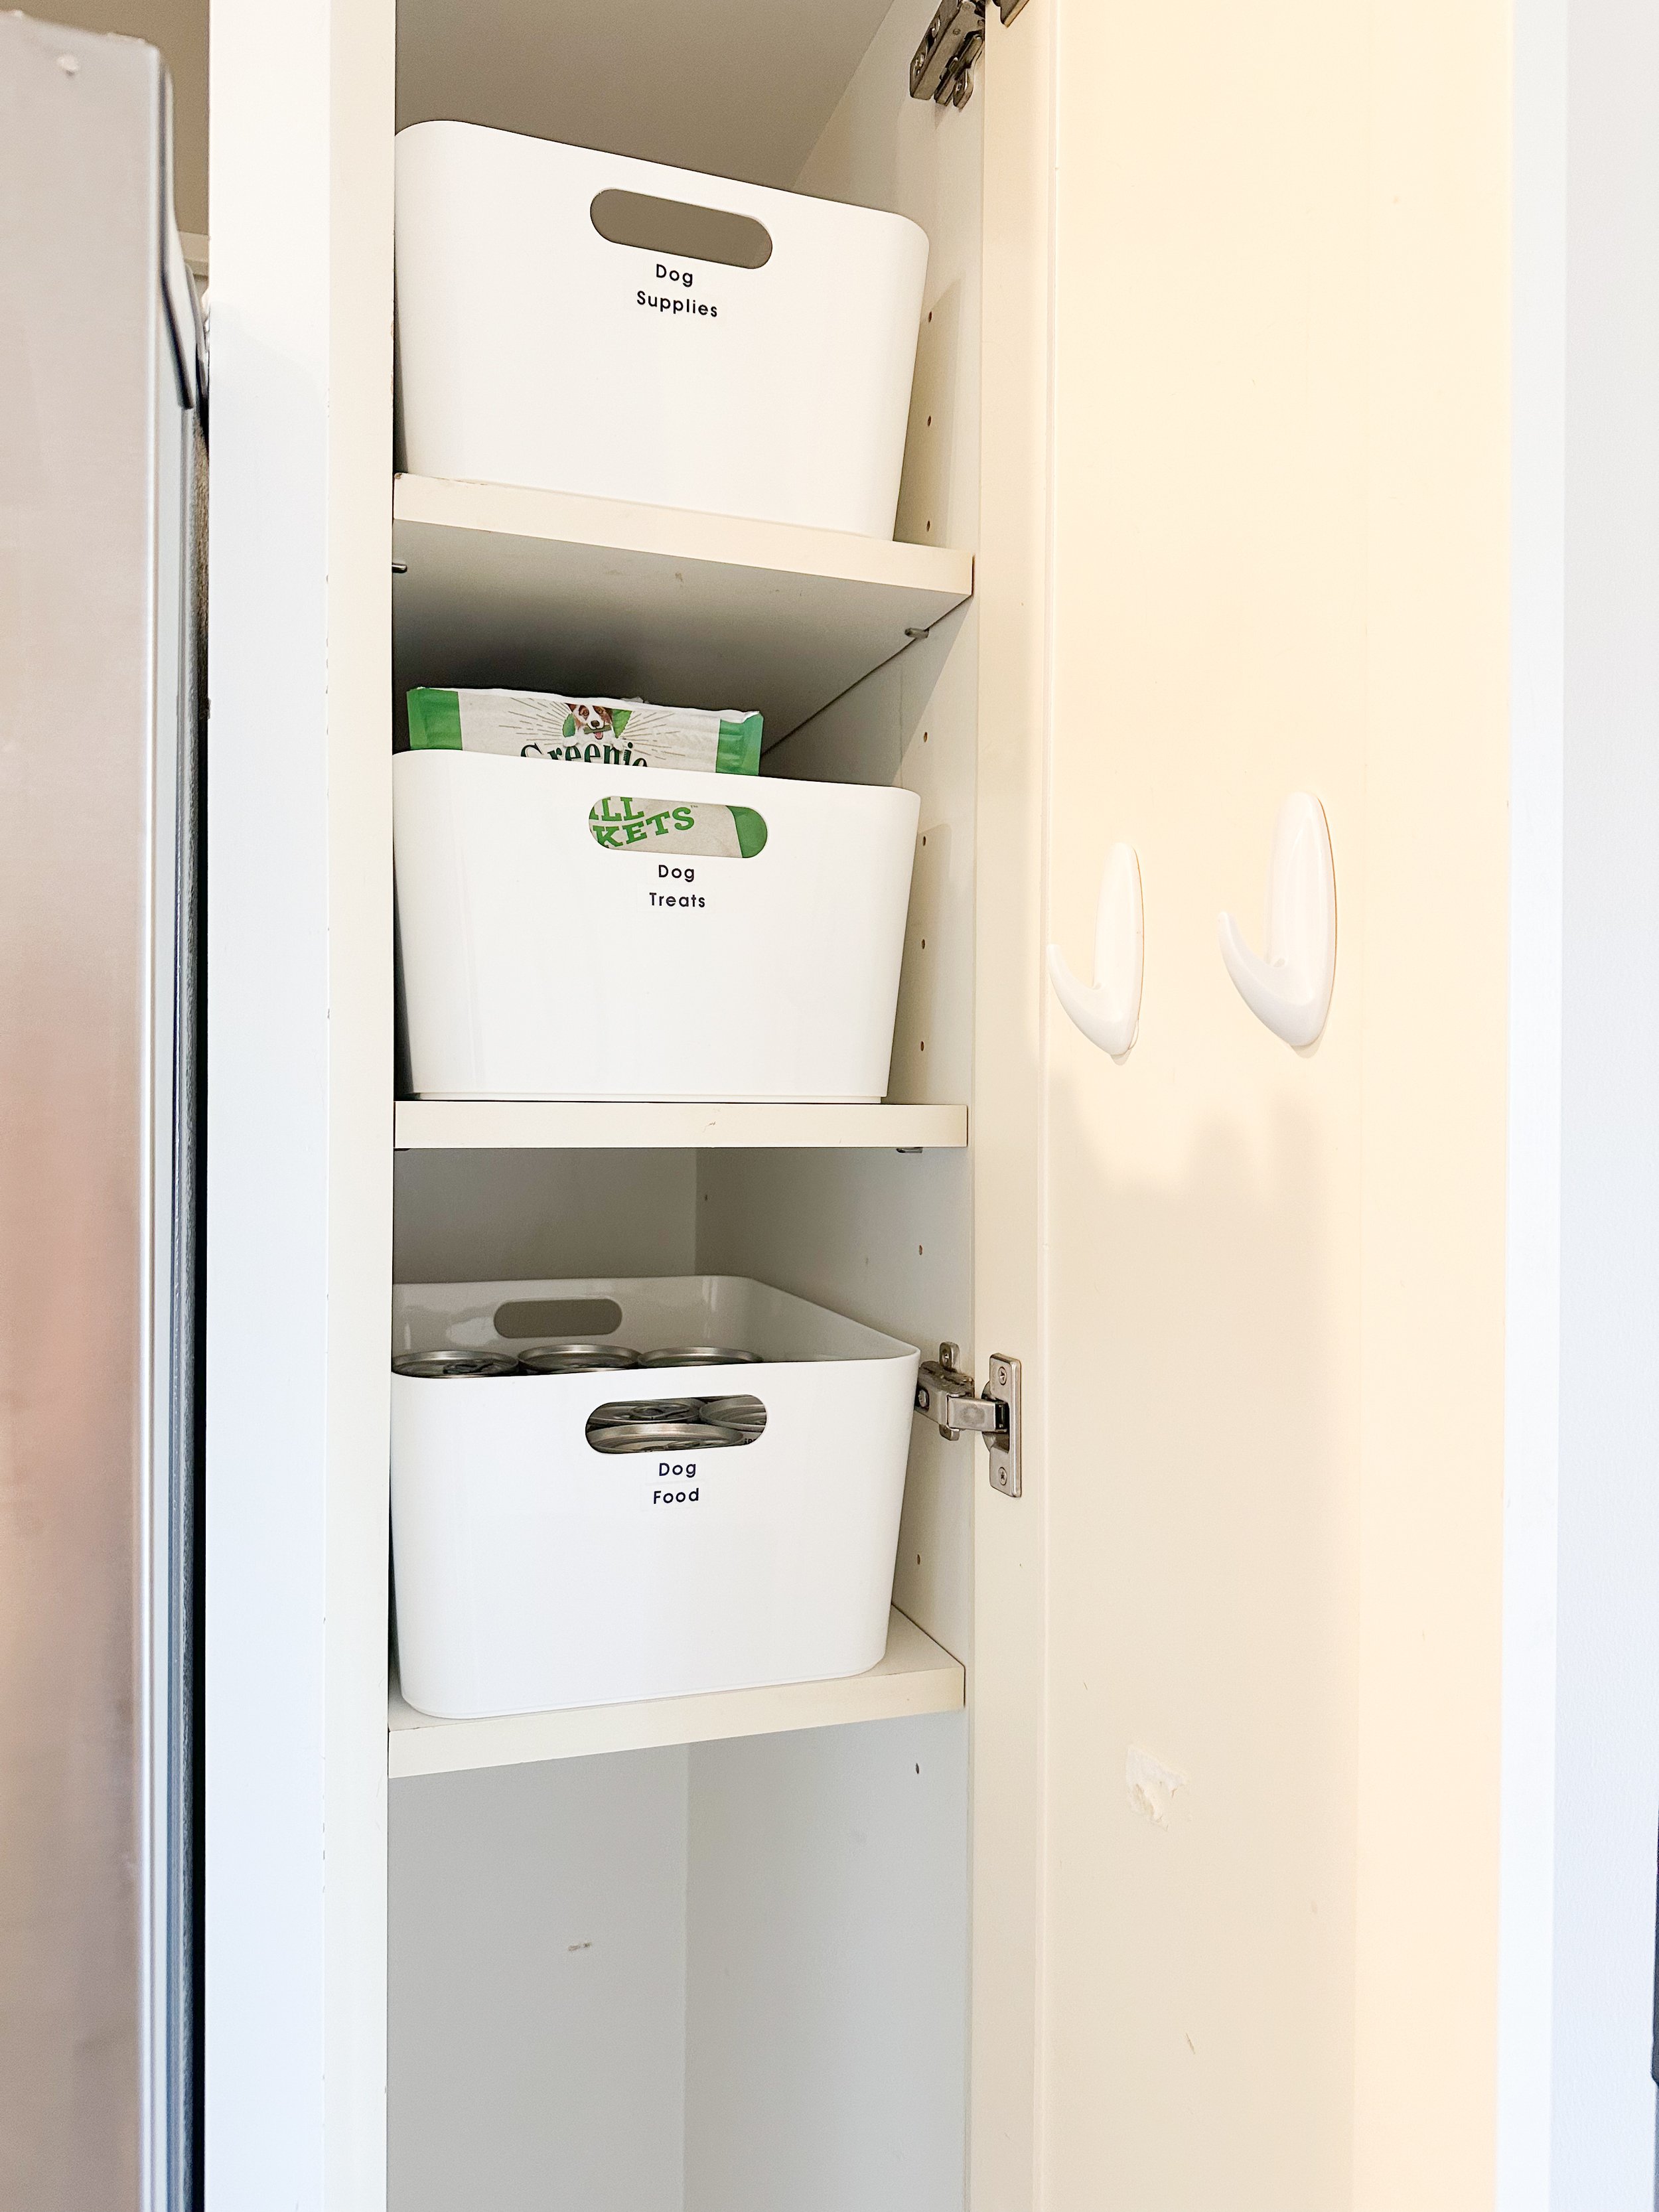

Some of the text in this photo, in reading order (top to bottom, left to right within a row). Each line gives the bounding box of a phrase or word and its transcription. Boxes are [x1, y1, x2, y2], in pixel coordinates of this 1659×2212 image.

[656, 263, 693, 287] Dog
[636, 290, 718, 318] Supplies
[658, 864, 695, 883] Dog
[649, 892, 705, 908] Treats
[659, 1462, 696, 1479] Dog
[653, 1487, 699, 1505] Food
